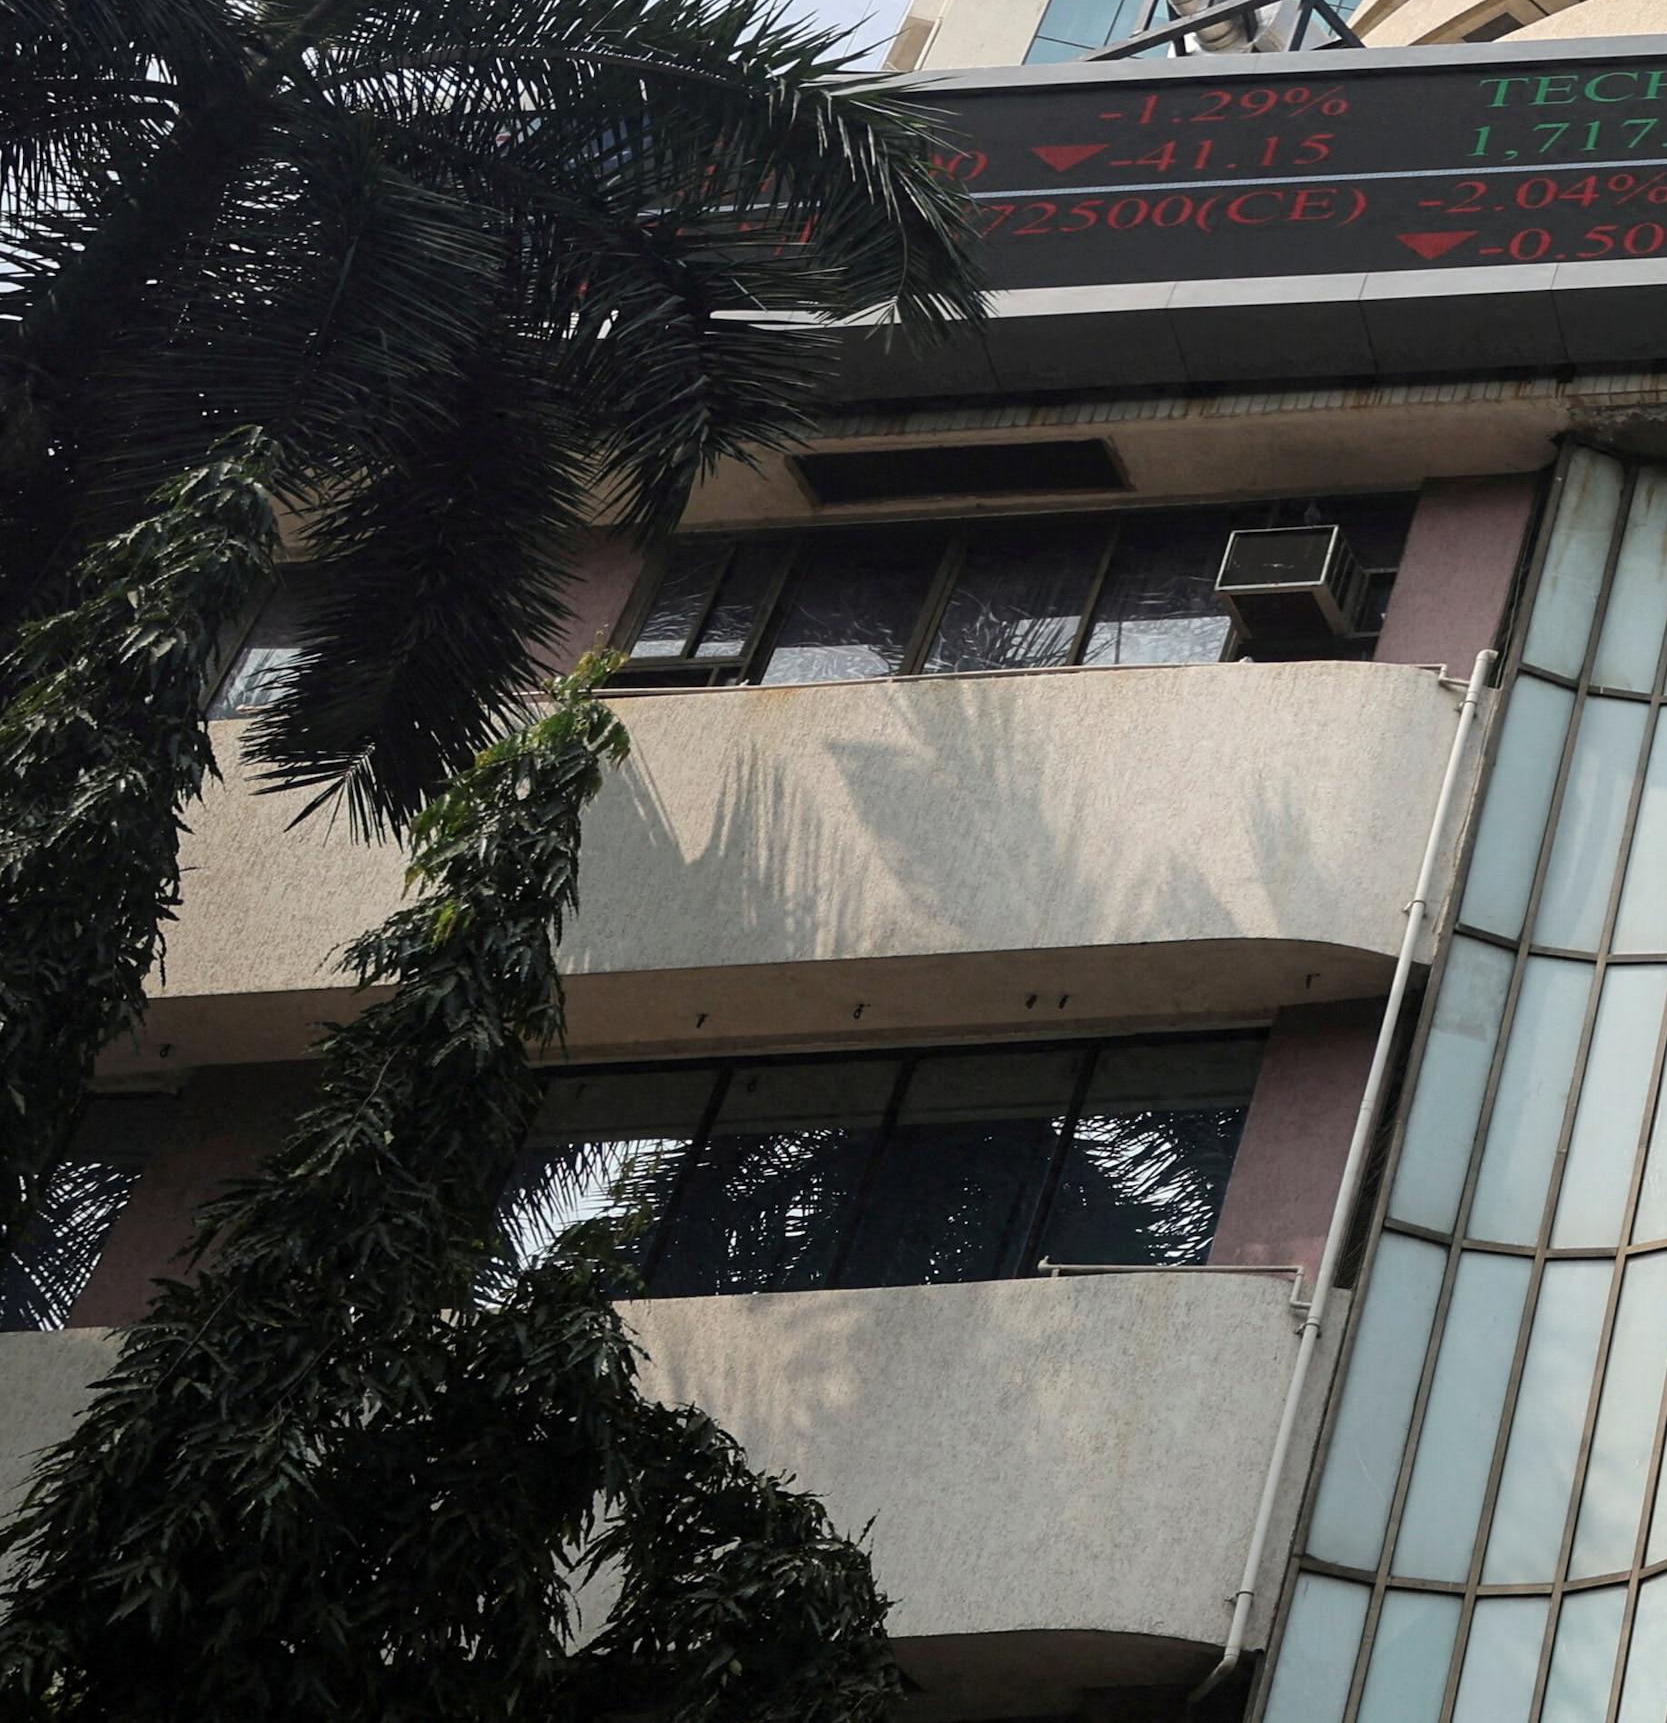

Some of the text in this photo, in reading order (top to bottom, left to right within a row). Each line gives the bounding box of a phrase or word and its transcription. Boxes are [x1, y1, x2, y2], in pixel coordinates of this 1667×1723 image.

[1101, 87, 1350, 125] -1.29%
[1111, 132, 1334, 172] -41.15
[1479, 223, 1667, 261] -0.50
